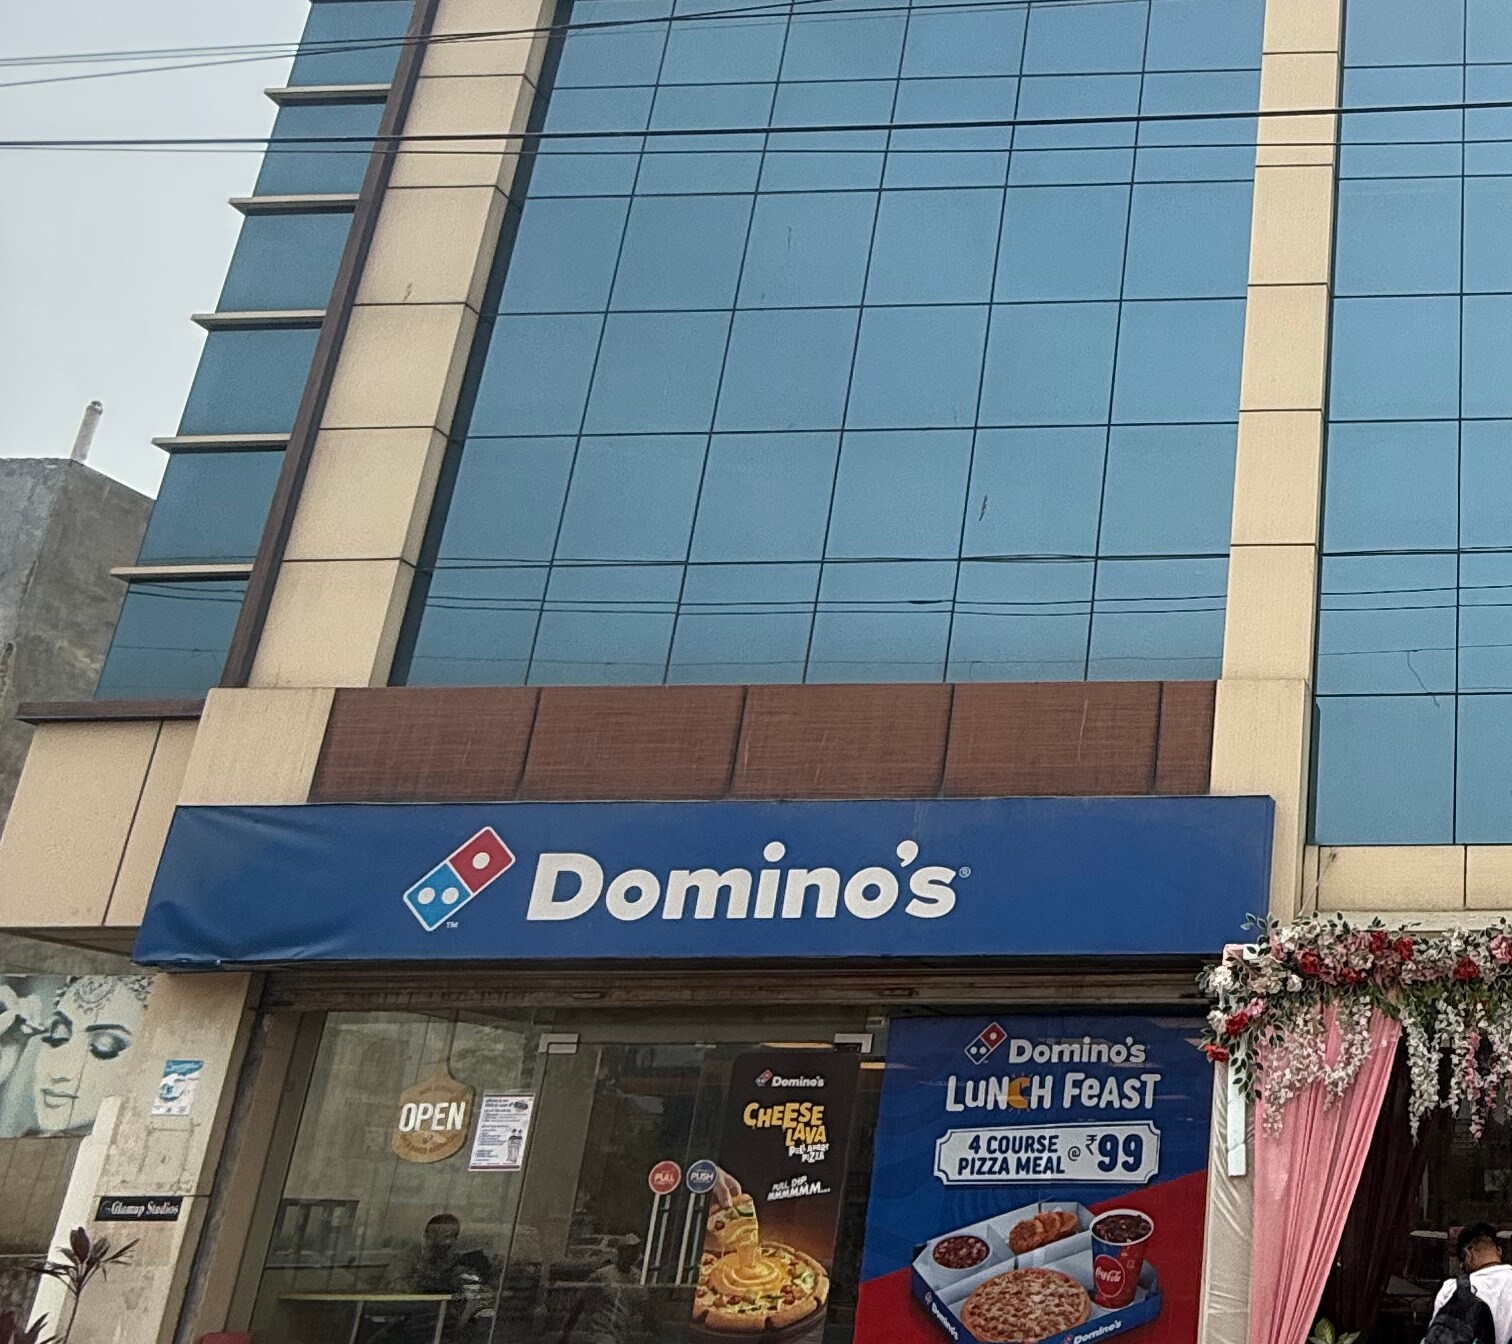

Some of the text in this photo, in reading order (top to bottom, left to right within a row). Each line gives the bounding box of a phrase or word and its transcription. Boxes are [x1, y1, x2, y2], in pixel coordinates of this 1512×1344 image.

[526, 839, 958, 921] Domino's
[1008, 1036, 1146, 1064] Domino's
[398, 1101, 466, 1132] OPEN
[743, 1102, 825, 1129] CHEESE
[785, 1123, 827, 1146] LAVA
[967, 1134, 1060, 1155] 4 COURSE
[1067, 1145, 1081, 1162] @
[691, 1172, 714, 1181] PUSH
[957, 1155, 1066, 1176] PIZZA MEAL
[654, 1173, 675, 1182] PULL
